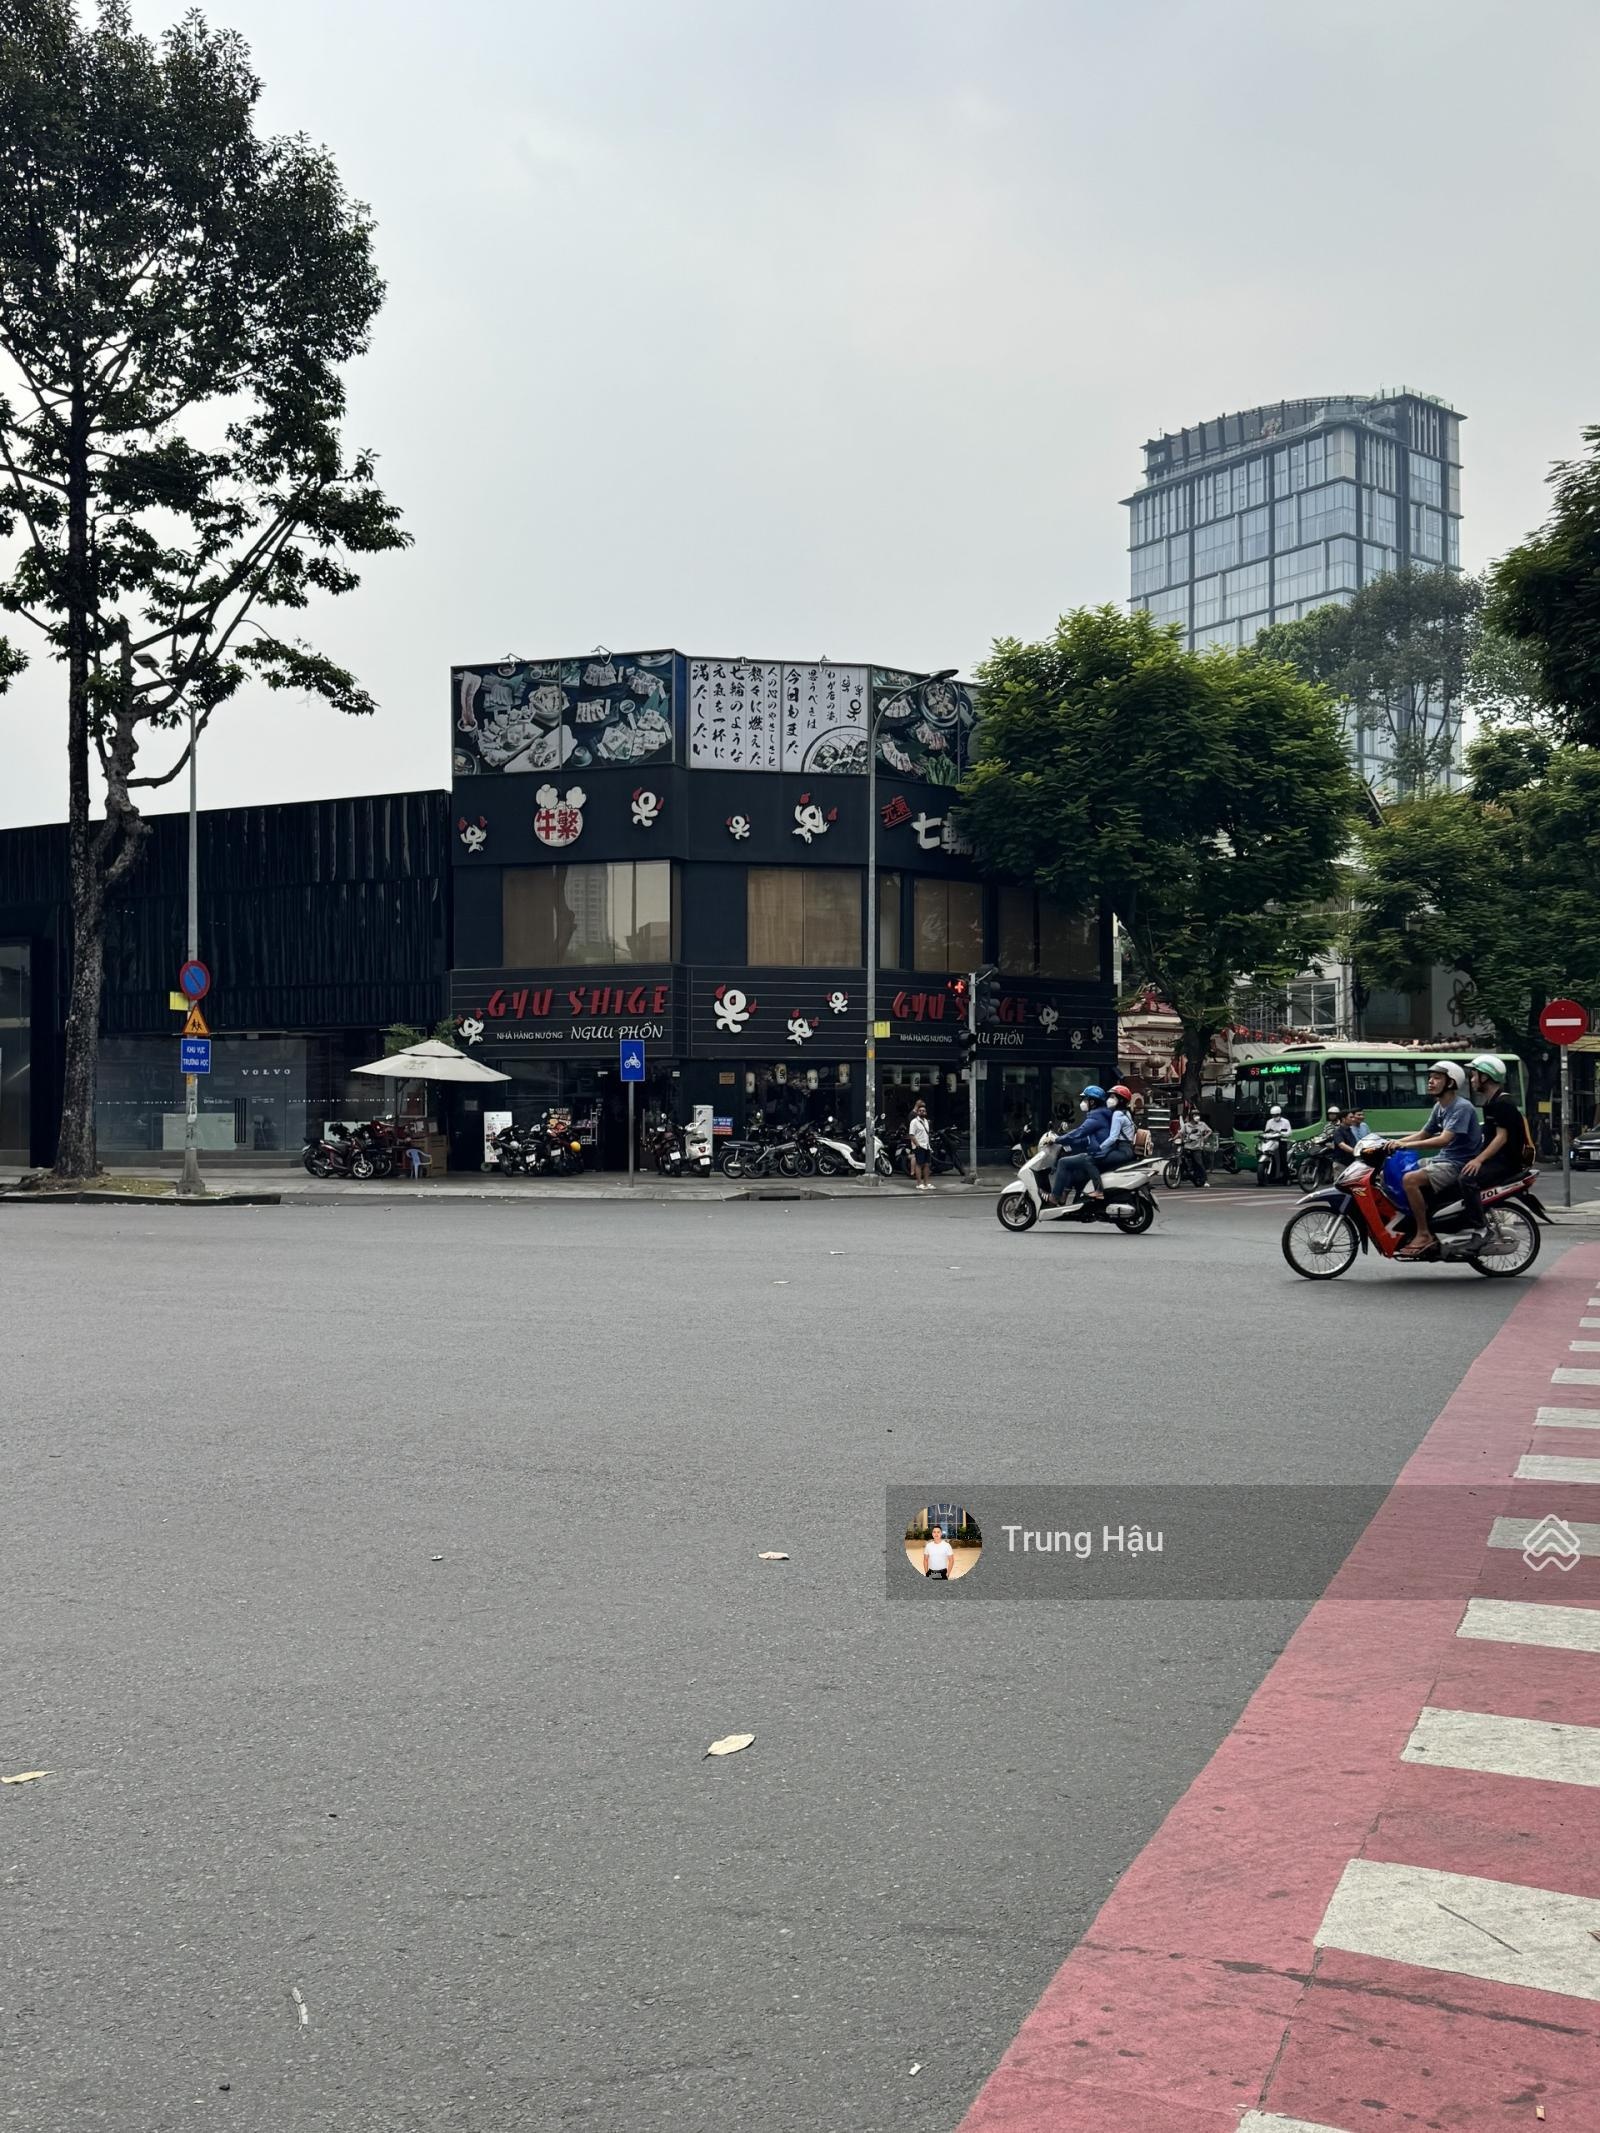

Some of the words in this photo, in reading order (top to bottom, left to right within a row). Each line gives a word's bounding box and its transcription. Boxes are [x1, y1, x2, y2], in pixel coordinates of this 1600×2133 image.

[536, 809, 579, 840] 牛繁
[487, 988, 553, 1019] GYU
[568, 985, 670, 1016] SHIGE
[892, 991, 946, 1022] GYU
